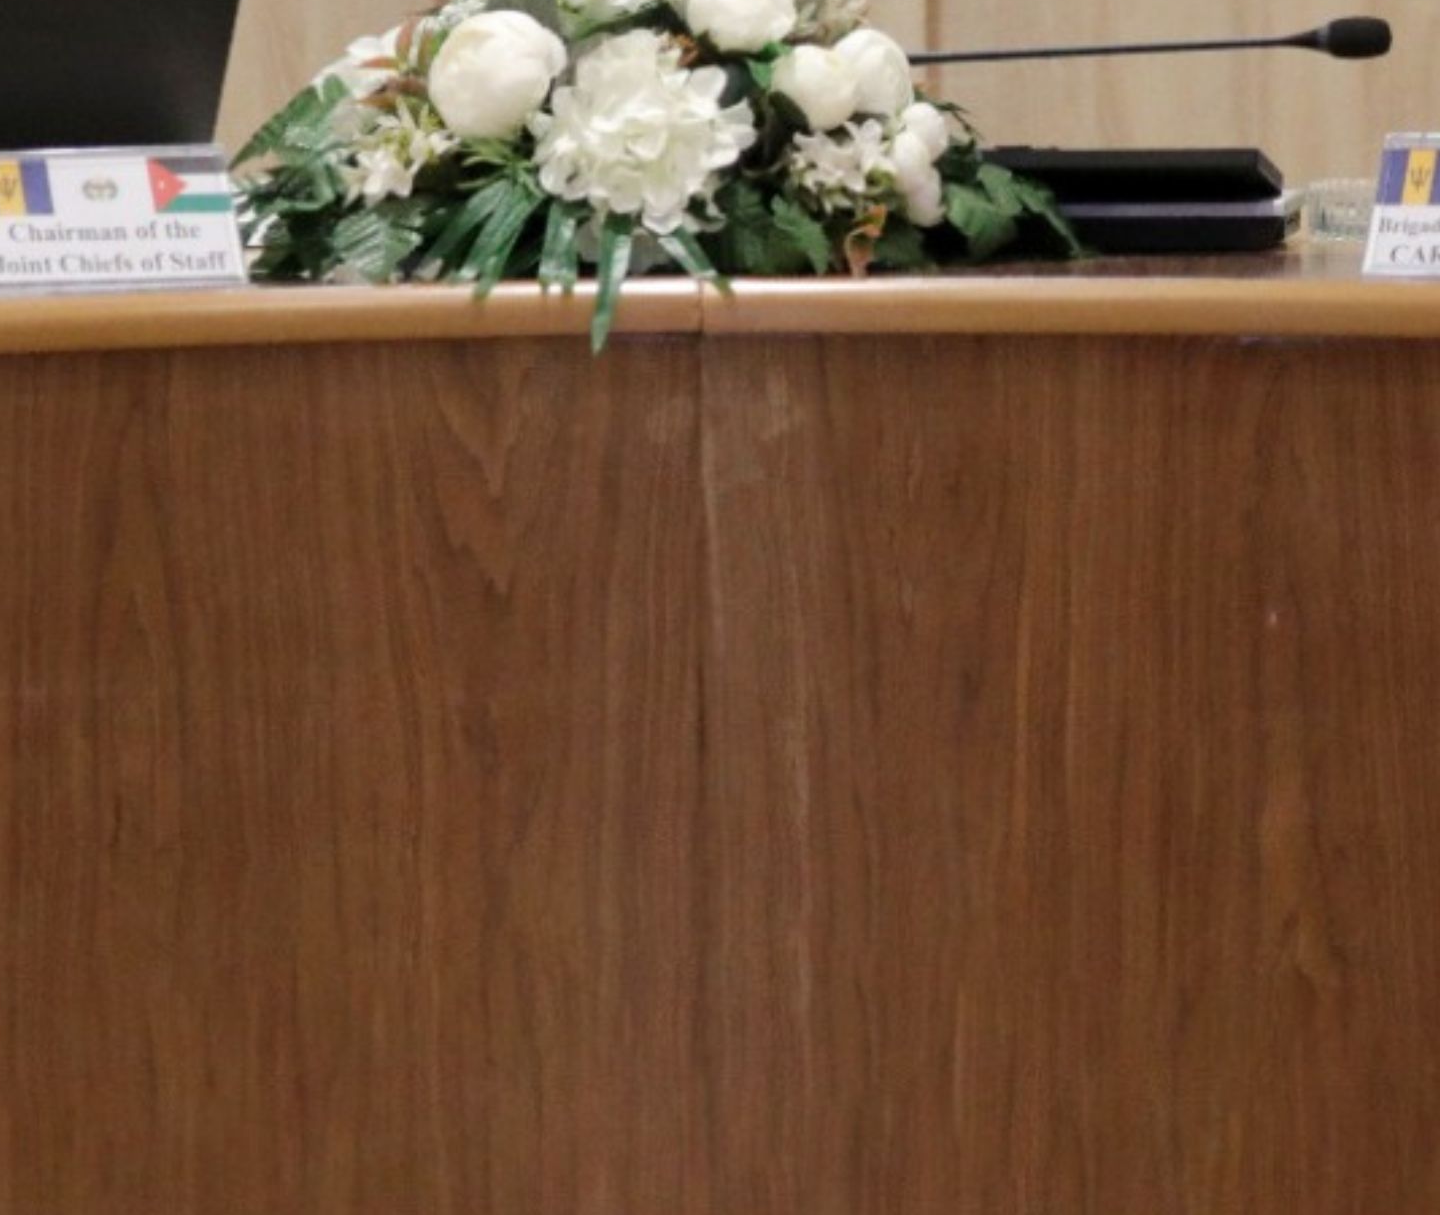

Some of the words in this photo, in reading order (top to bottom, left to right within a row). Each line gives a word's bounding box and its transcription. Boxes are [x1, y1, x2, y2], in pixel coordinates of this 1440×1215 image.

[8, 221, 129, 243] Chairman
[135, 220, 159, 240] of
[165, 217, 201, 239] the
[60, 252, 133, 274] Chiefs
[140, 251, 164, 272] of
[170, 248, 228, 271] Staff
